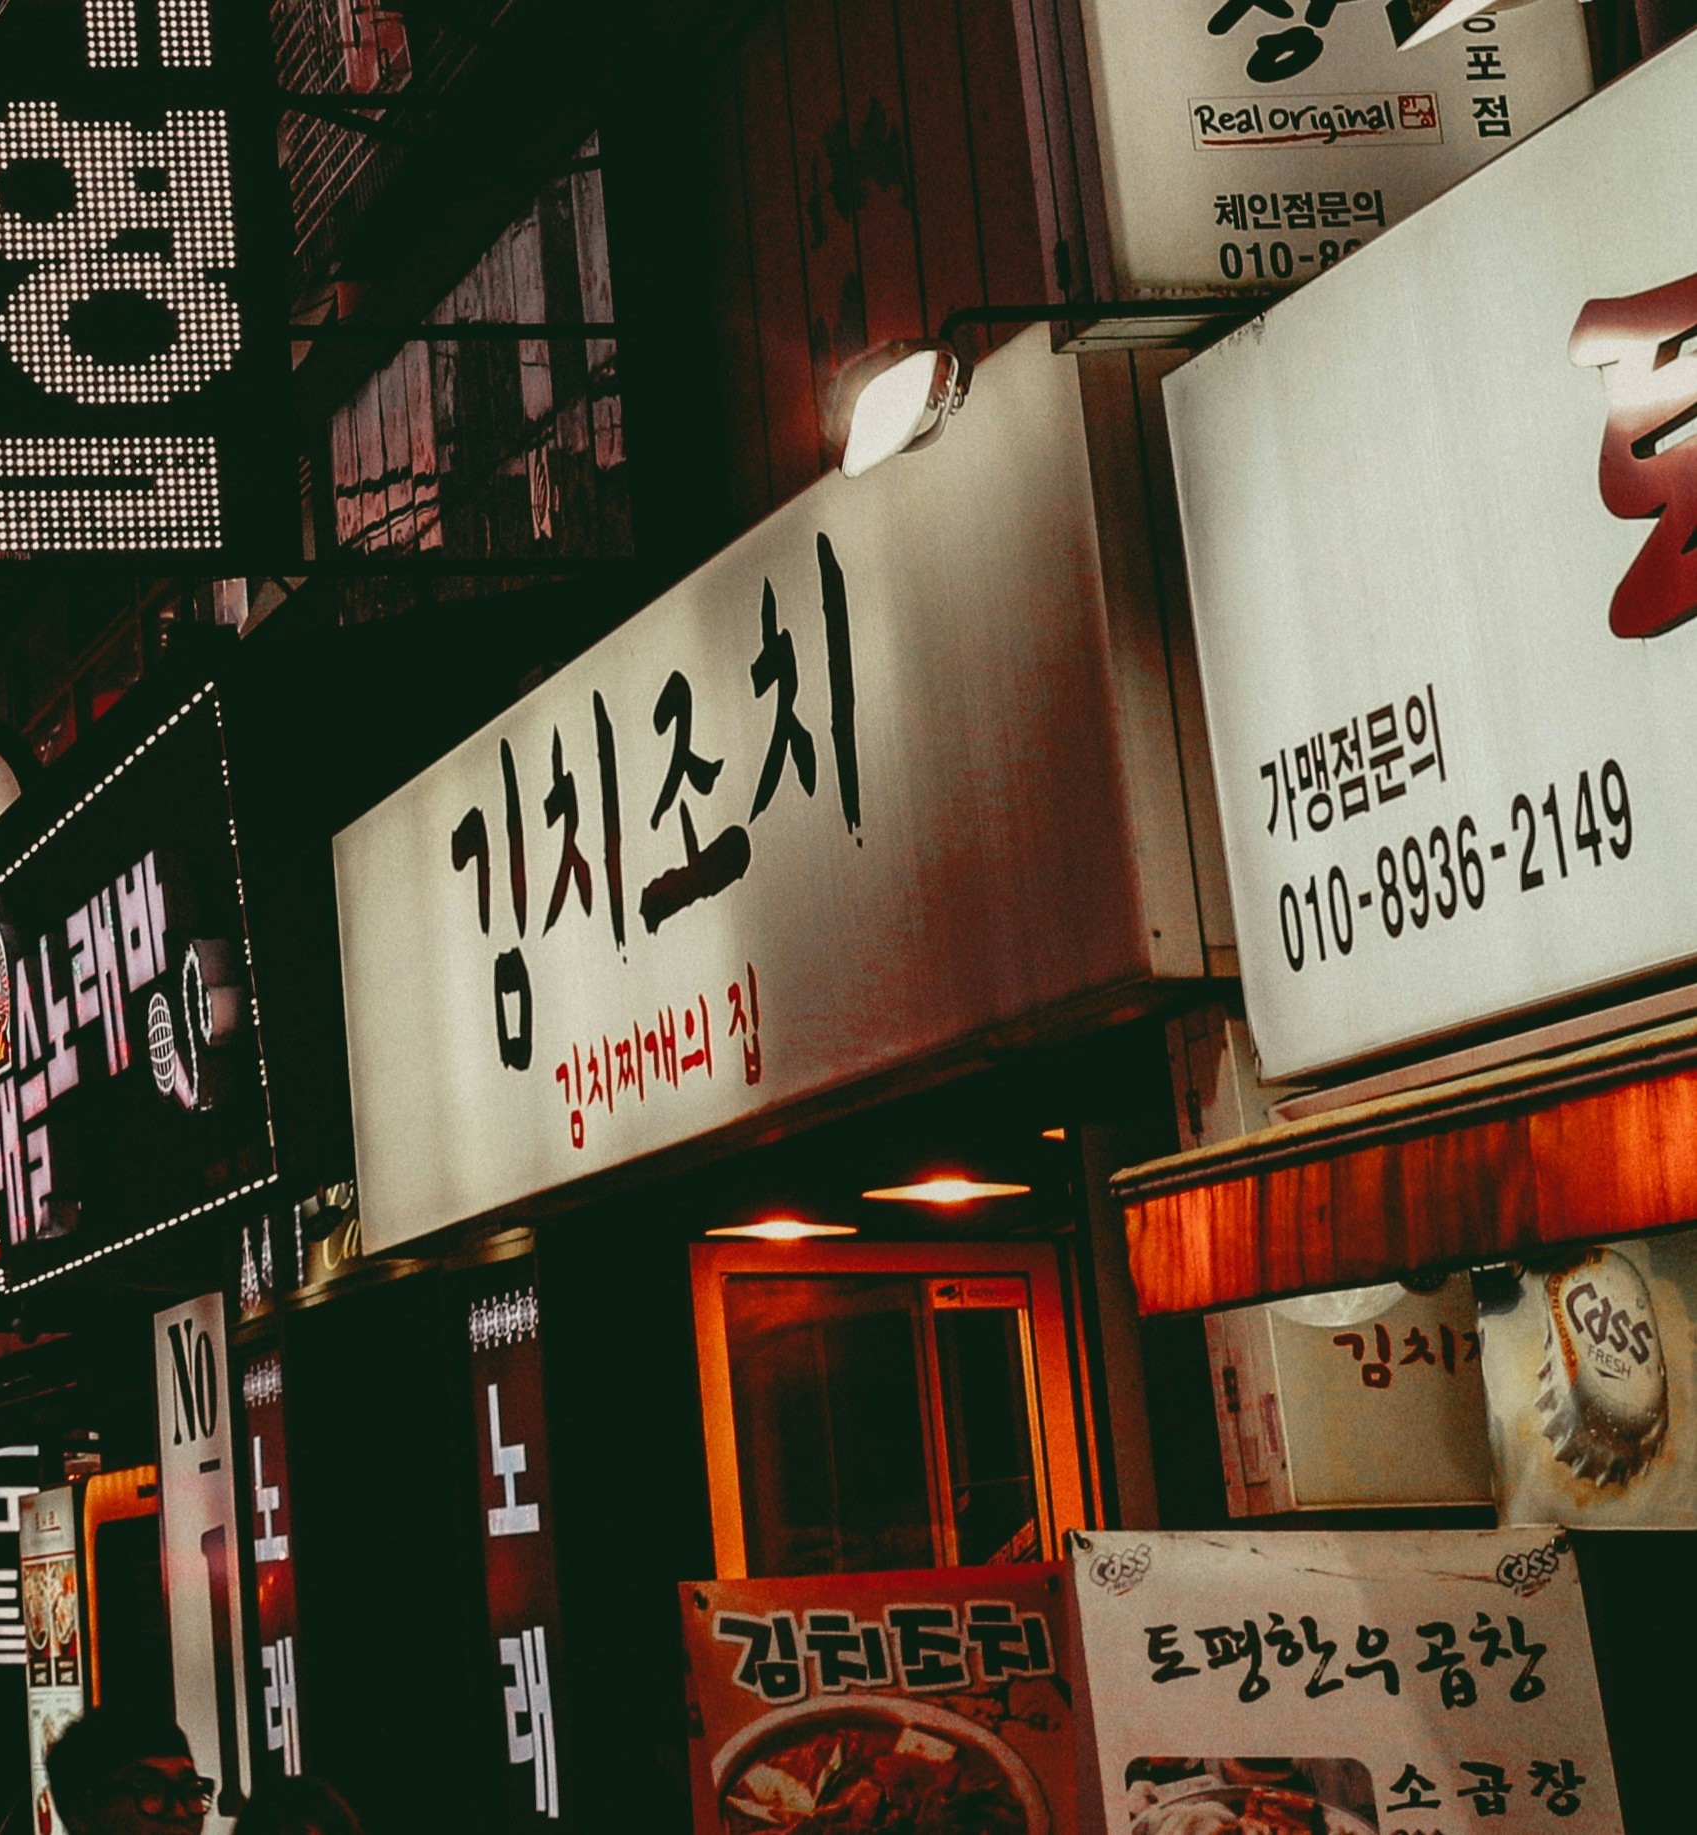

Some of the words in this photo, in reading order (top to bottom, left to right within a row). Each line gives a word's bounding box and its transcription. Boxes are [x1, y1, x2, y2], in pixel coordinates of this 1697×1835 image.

[1194, 104, 1263, 135] Real
[1214, 190, 1385, 230] 체인점문의
[452, 532, 863, 1072] 김치조치
[1260, 683, 1447, 842] 가맹점문의
[1279, 758, 1634, 973] 010-8936-2149
[556, 996, 713, 1150] 김치찌개의
[728, 962, 763, 1087] 집
[1587, 1346, 1632, 1379] FRESH
[486, 1382, 560, 1819] 노래
[713, 1600, 1053, 1703] 김치조치
